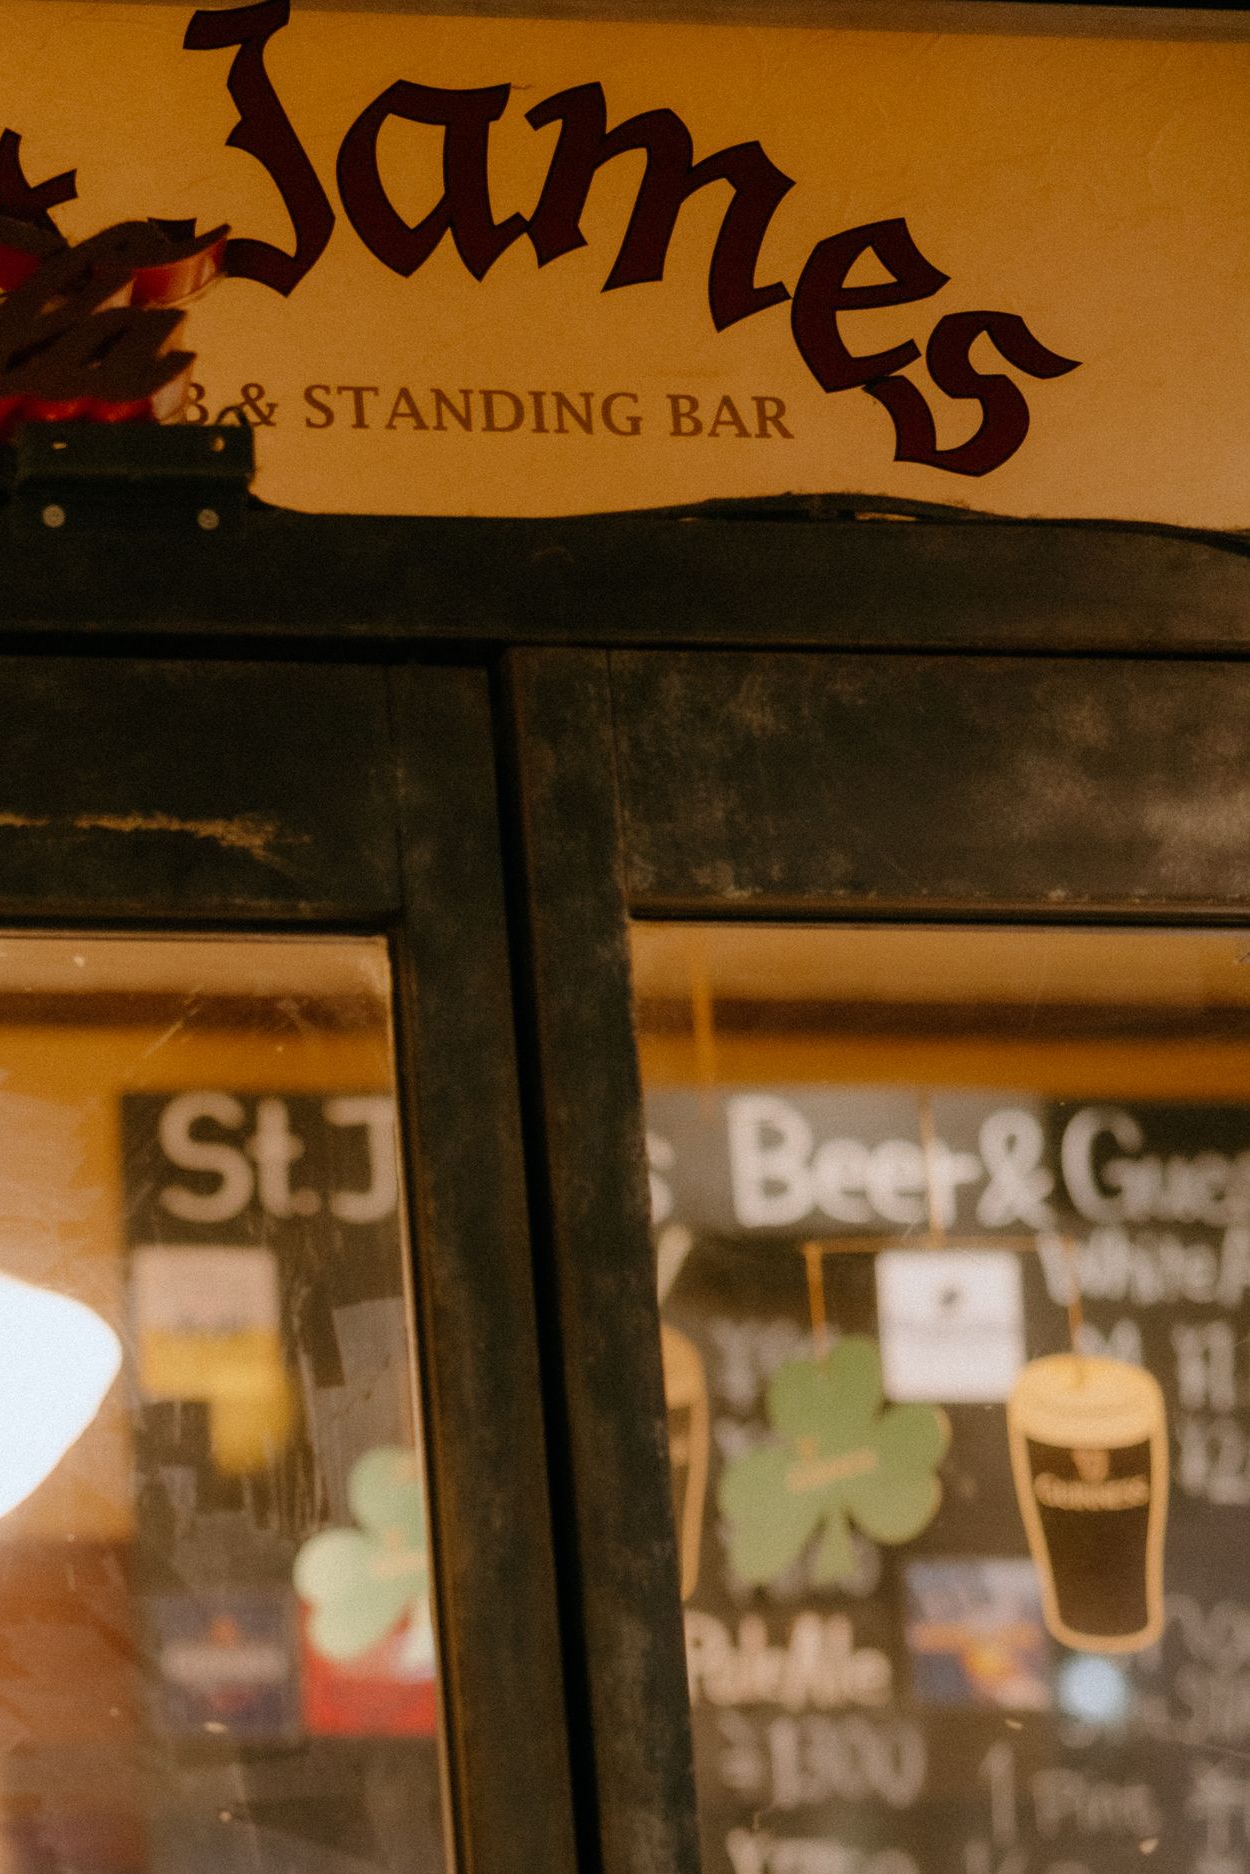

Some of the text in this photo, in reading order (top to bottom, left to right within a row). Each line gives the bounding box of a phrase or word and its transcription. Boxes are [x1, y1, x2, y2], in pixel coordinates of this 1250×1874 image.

[182, 0, 1084, 478] James
[302, 381, 644, 438] STANDING
[666, 391, 796, 441] BAR
[727, 1094, 982, 1230] Beer
